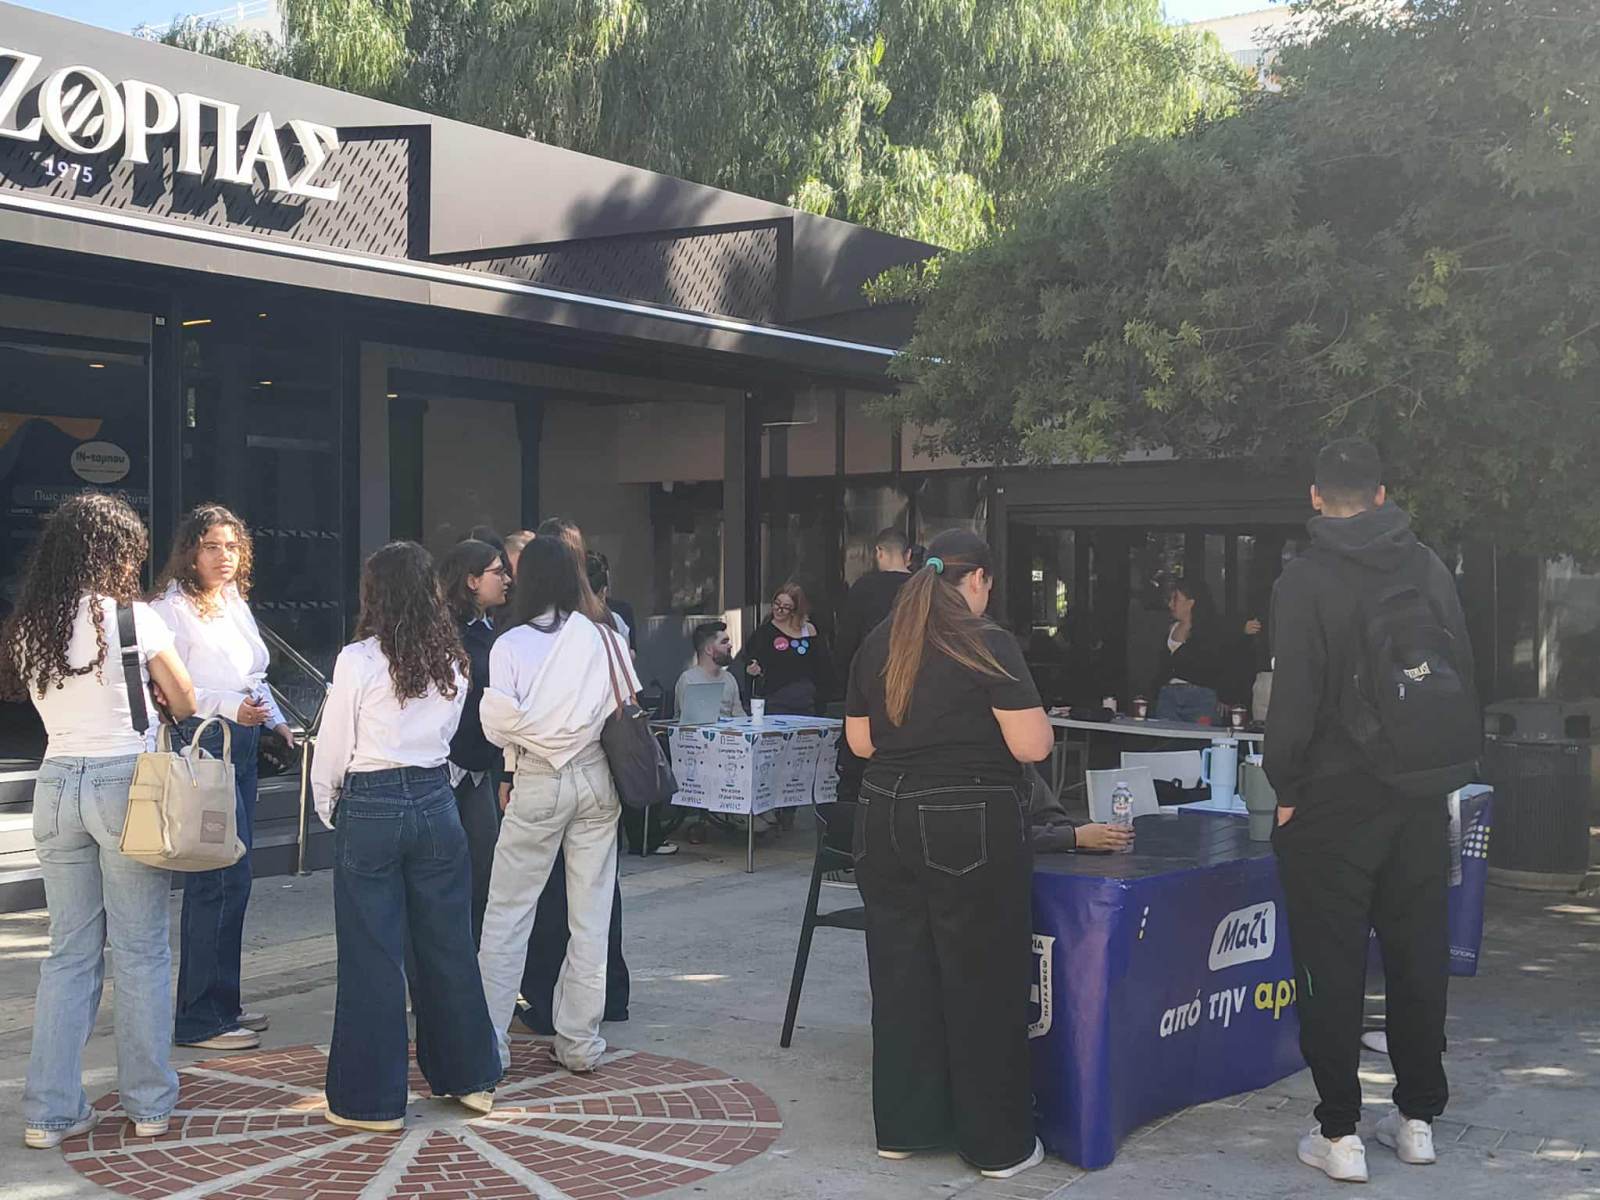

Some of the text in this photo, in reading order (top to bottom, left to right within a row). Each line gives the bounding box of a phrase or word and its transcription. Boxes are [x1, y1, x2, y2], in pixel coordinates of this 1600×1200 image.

[44, 158, 94, 184] 1975
[1217, 908, 1268, 955] Μαζί
[1159, 988, 1201, 1038] από
[1208, 985, 1247, 1028] την
